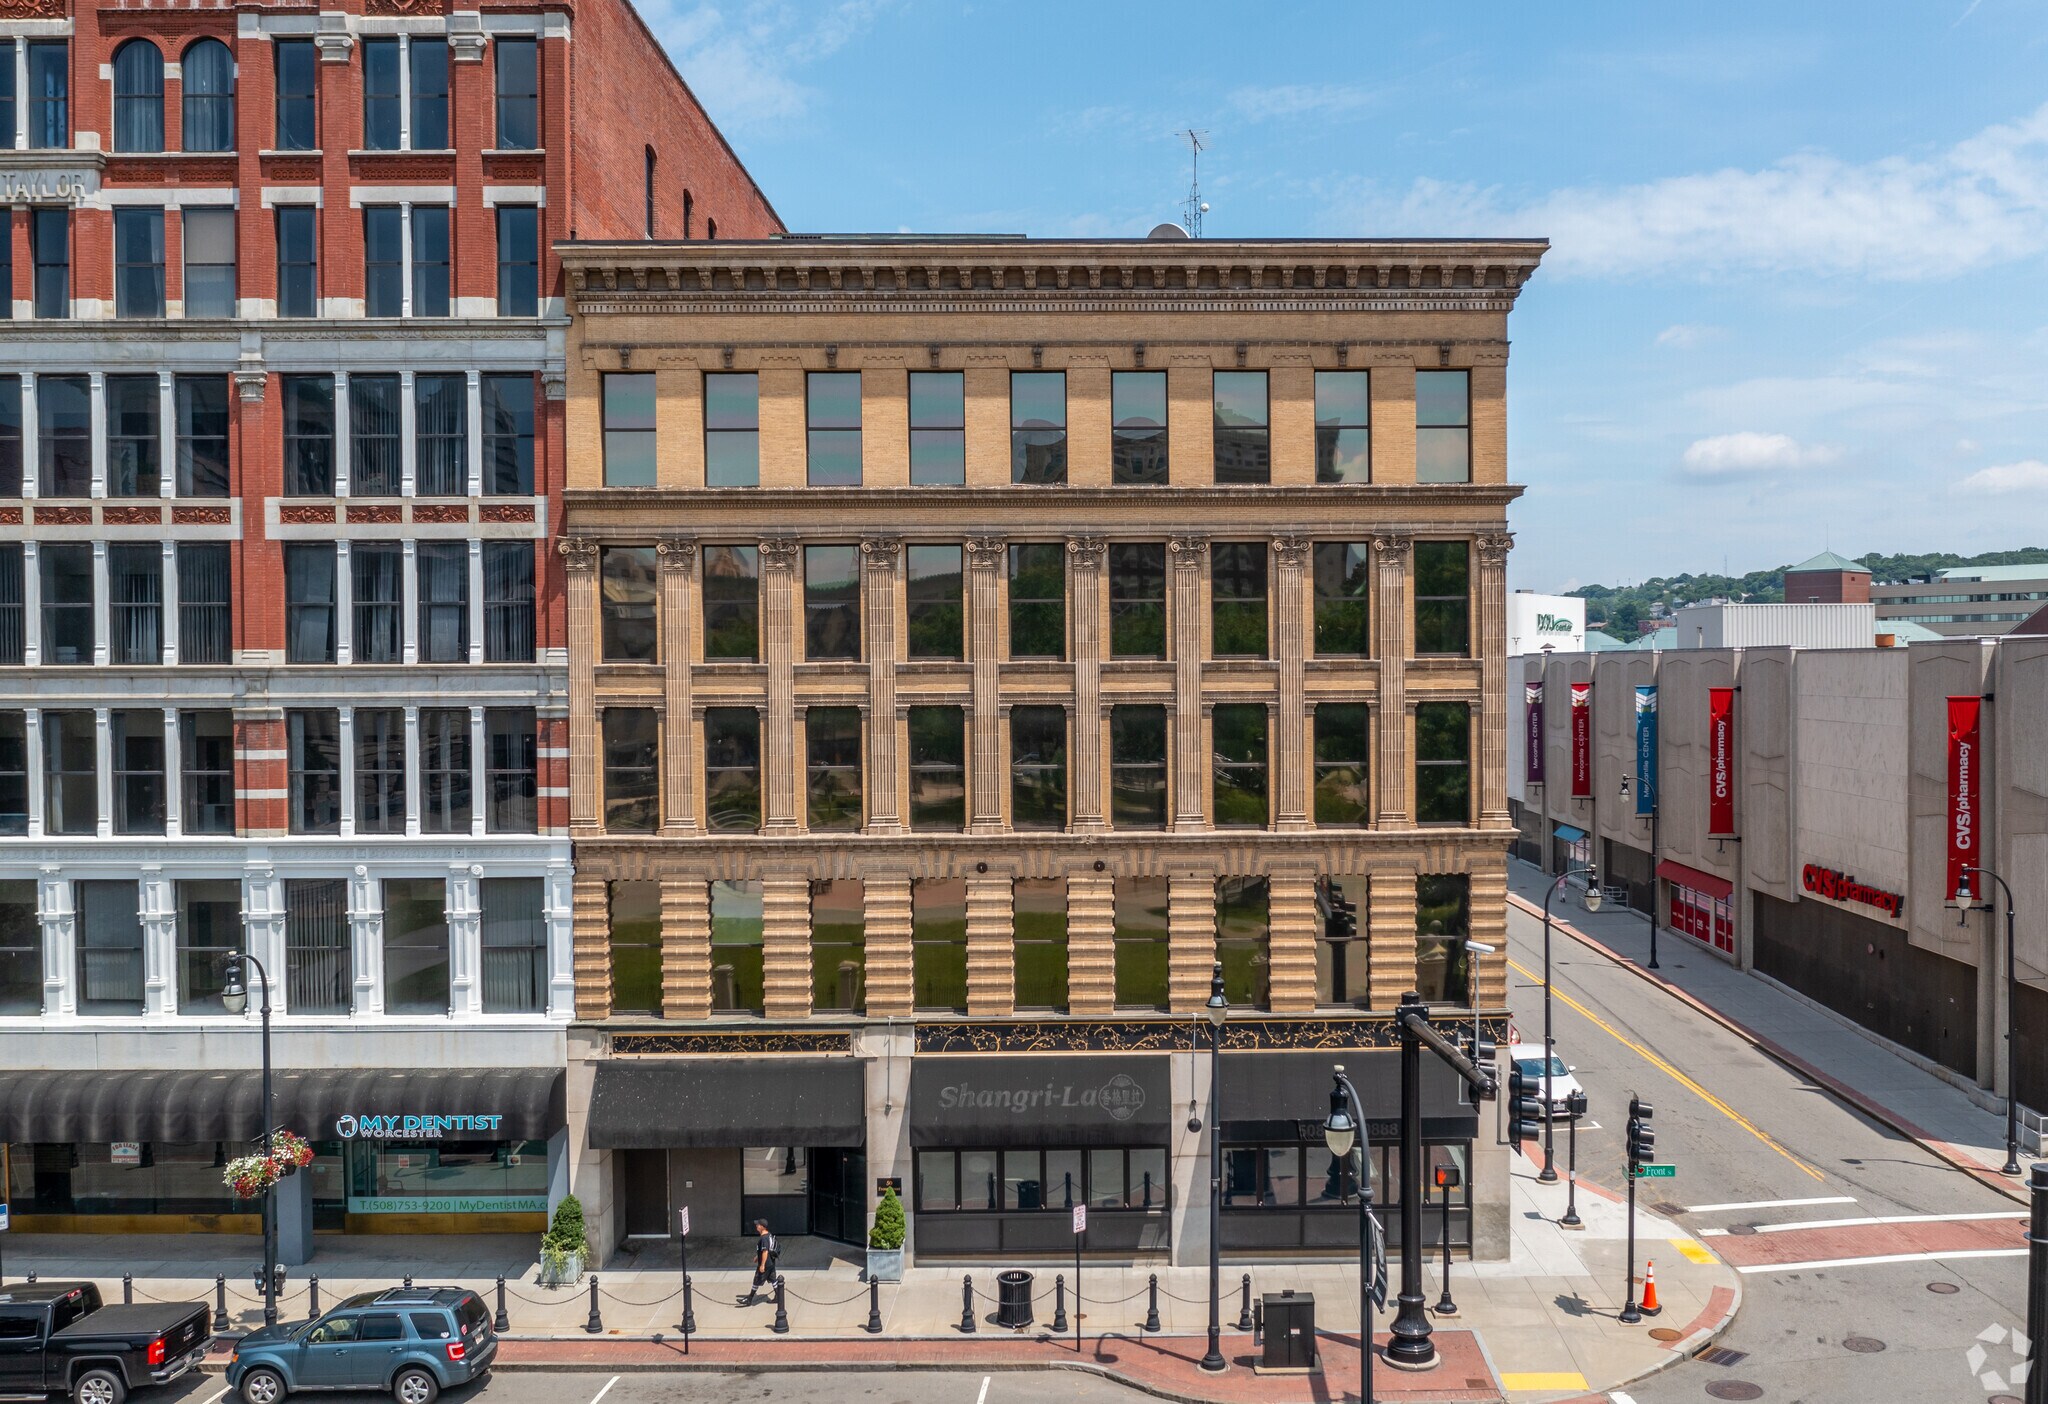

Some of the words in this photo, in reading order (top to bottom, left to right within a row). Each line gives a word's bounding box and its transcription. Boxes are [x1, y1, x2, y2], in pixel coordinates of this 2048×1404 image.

[2, 173, 87, 199] TAYLOR
[1716, 720, 1727, 798] CVS/pharmacy
[1956, 742, 1971, 850] CVS/pharmacy
[1803, 864, 1903, 918] CVS/pharmacy
[938, 1082, 1098, 1113] Shangri-La
[360, 1115, 400, 1130] MY
[404, 1115, 502, 1130] DENTIST
[360, 1129, 443, 1138] WORCESTER
[1646, 1166, 1666, 1177] Front
